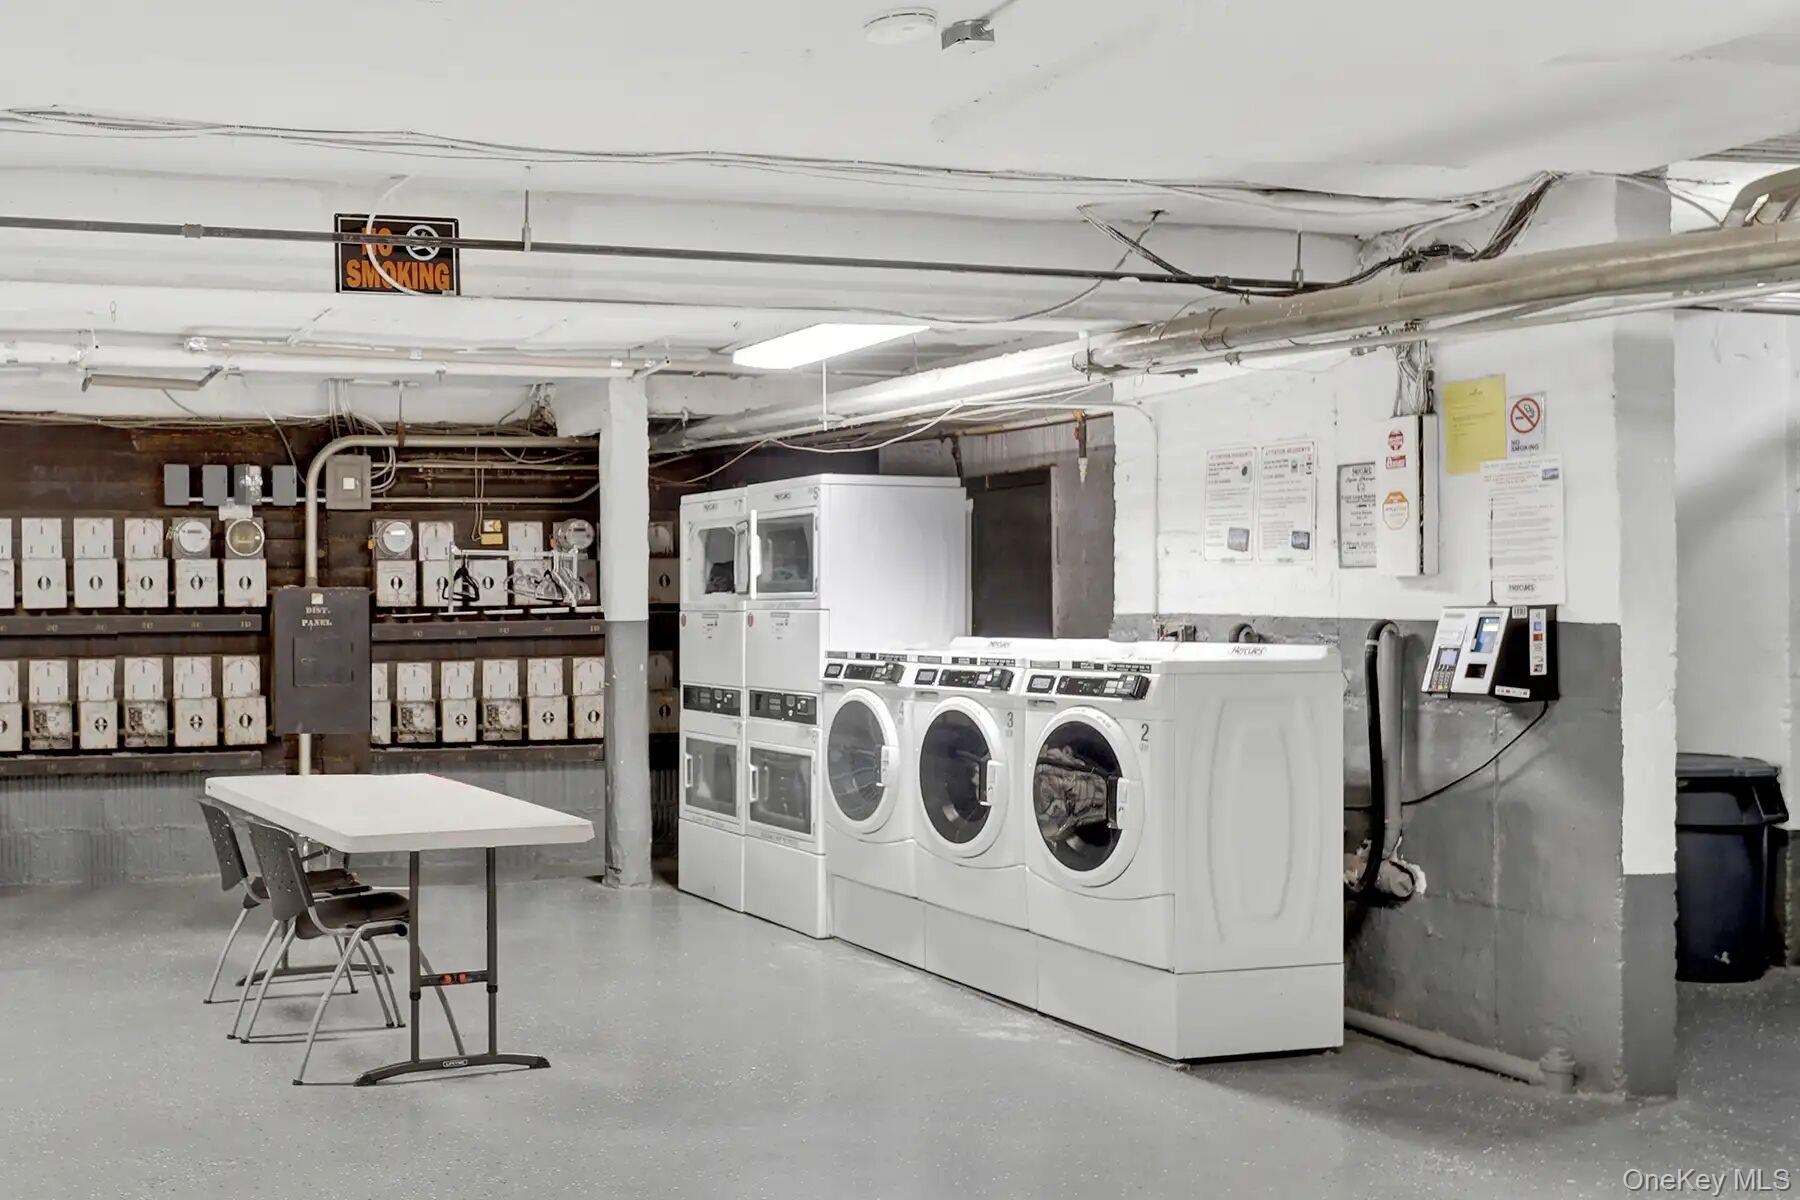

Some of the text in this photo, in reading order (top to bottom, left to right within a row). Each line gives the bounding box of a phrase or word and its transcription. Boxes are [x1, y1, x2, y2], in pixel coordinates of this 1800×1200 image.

[346, 258, 450, 291] SMOKING
[1511, 444, 1540, 452] SMOKING
[305, 606, 331, 614] DIST.
[301, 619, 333, 627] PANEL
[1006, 711, 1014, 728] 3
[1140, 723, 1150, 742] 2
